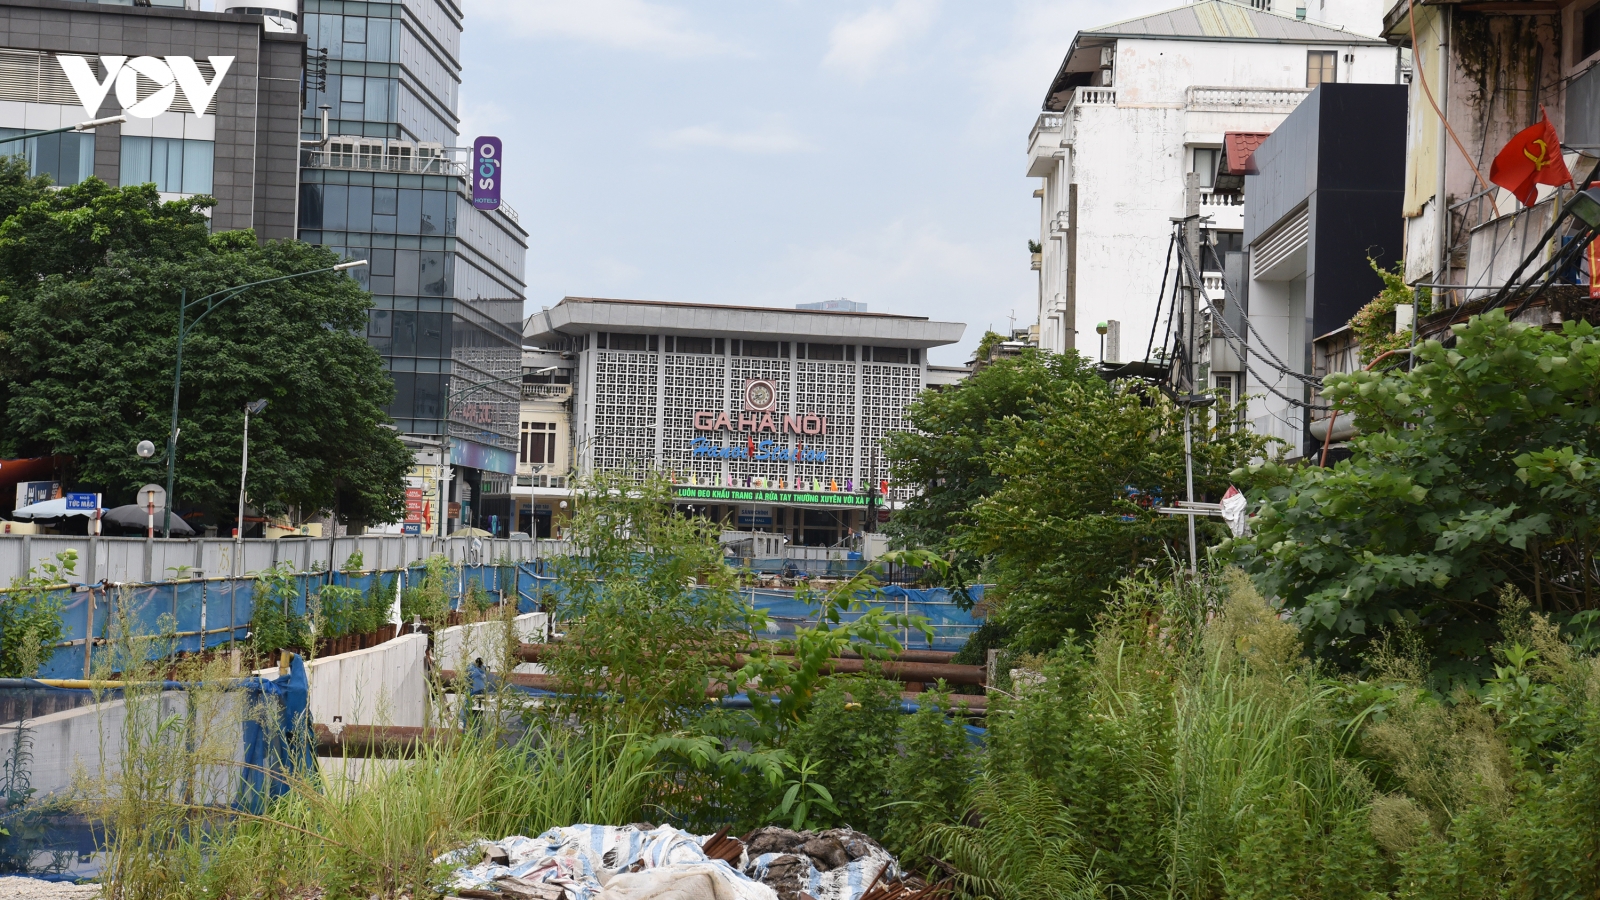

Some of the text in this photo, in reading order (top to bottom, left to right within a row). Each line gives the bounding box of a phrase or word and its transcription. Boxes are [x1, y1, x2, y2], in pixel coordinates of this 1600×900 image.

[479, 143, 500, 190] sojo
[694, 410, 827, 435] GA HÀ NỘI
[690, 436, 828, 462] Hanoi Station
[678, 488, 696, 497] LUÔN
[732, 491, 753, 500] TRANG
[780, 493, 792, 501] TAY
[820, 494, 842, 504] XUYÊN
[856, 495, 864, 504] XÀ
